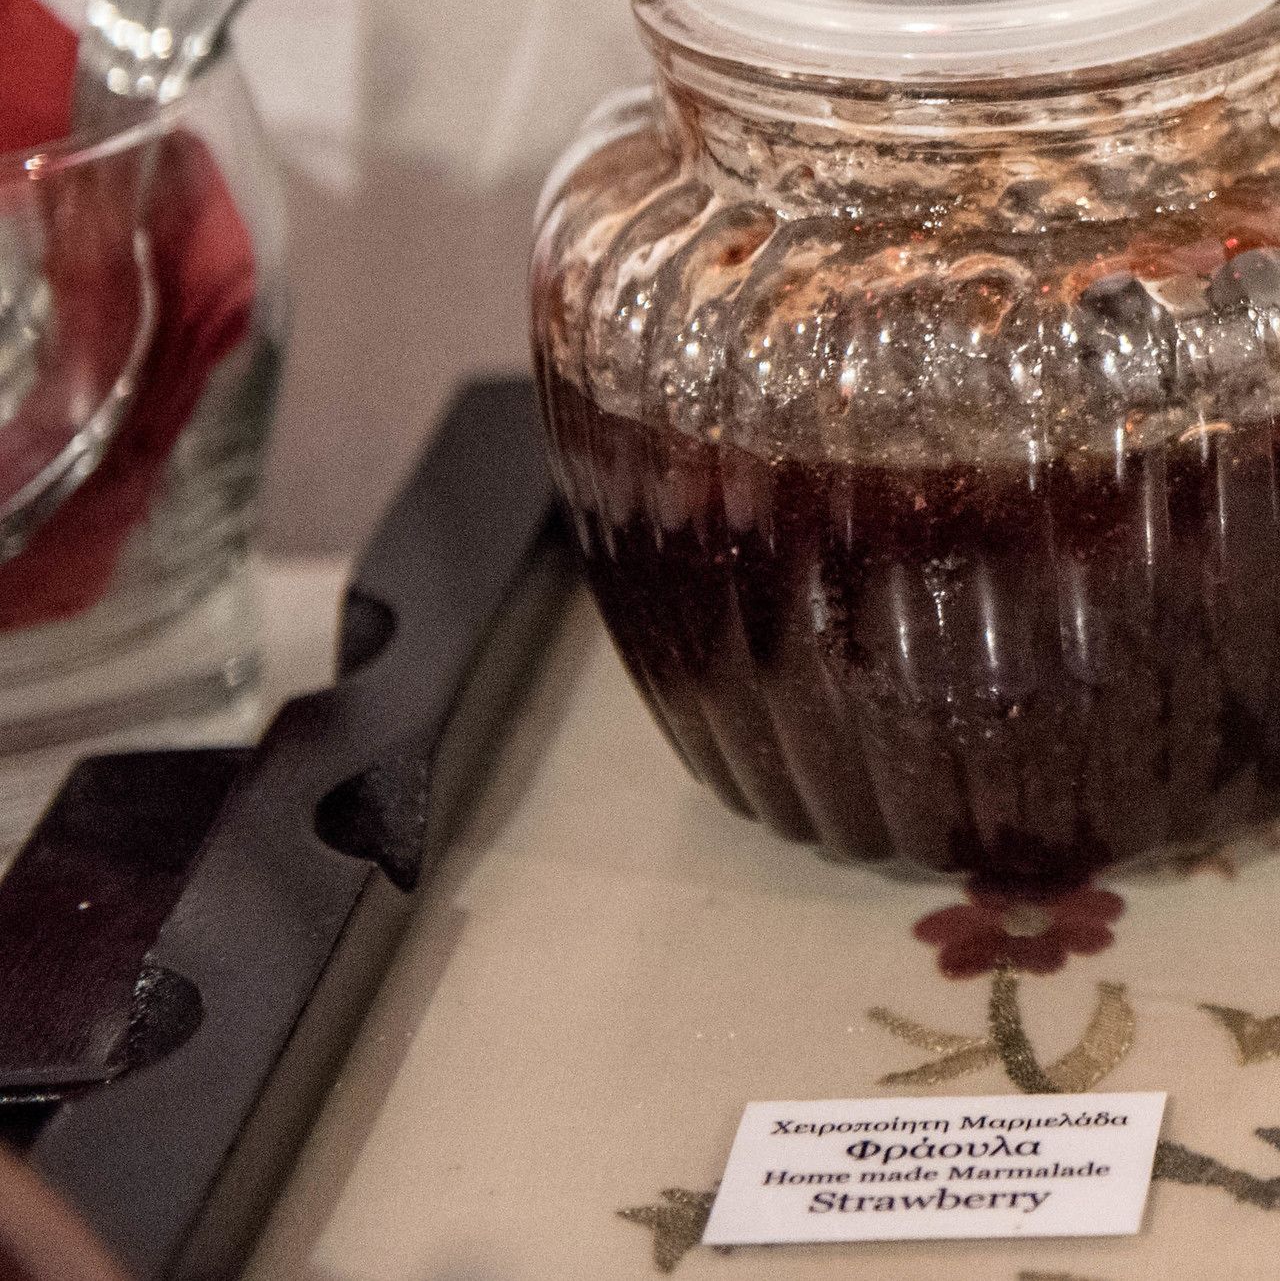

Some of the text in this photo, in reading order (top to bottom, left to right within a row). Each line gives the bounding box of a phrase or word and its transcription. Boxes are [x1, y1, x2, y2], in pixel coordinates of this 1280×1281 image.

[770, 1111, 1129, 1136] Χειροποίητη Μαρμελάδα
[846, 1136, 1042, 1164] Φράουλα
[762, 1161, 1111, 1186] Home made Marmalade
[807, 1188, 1052, 1214] Strawberry
